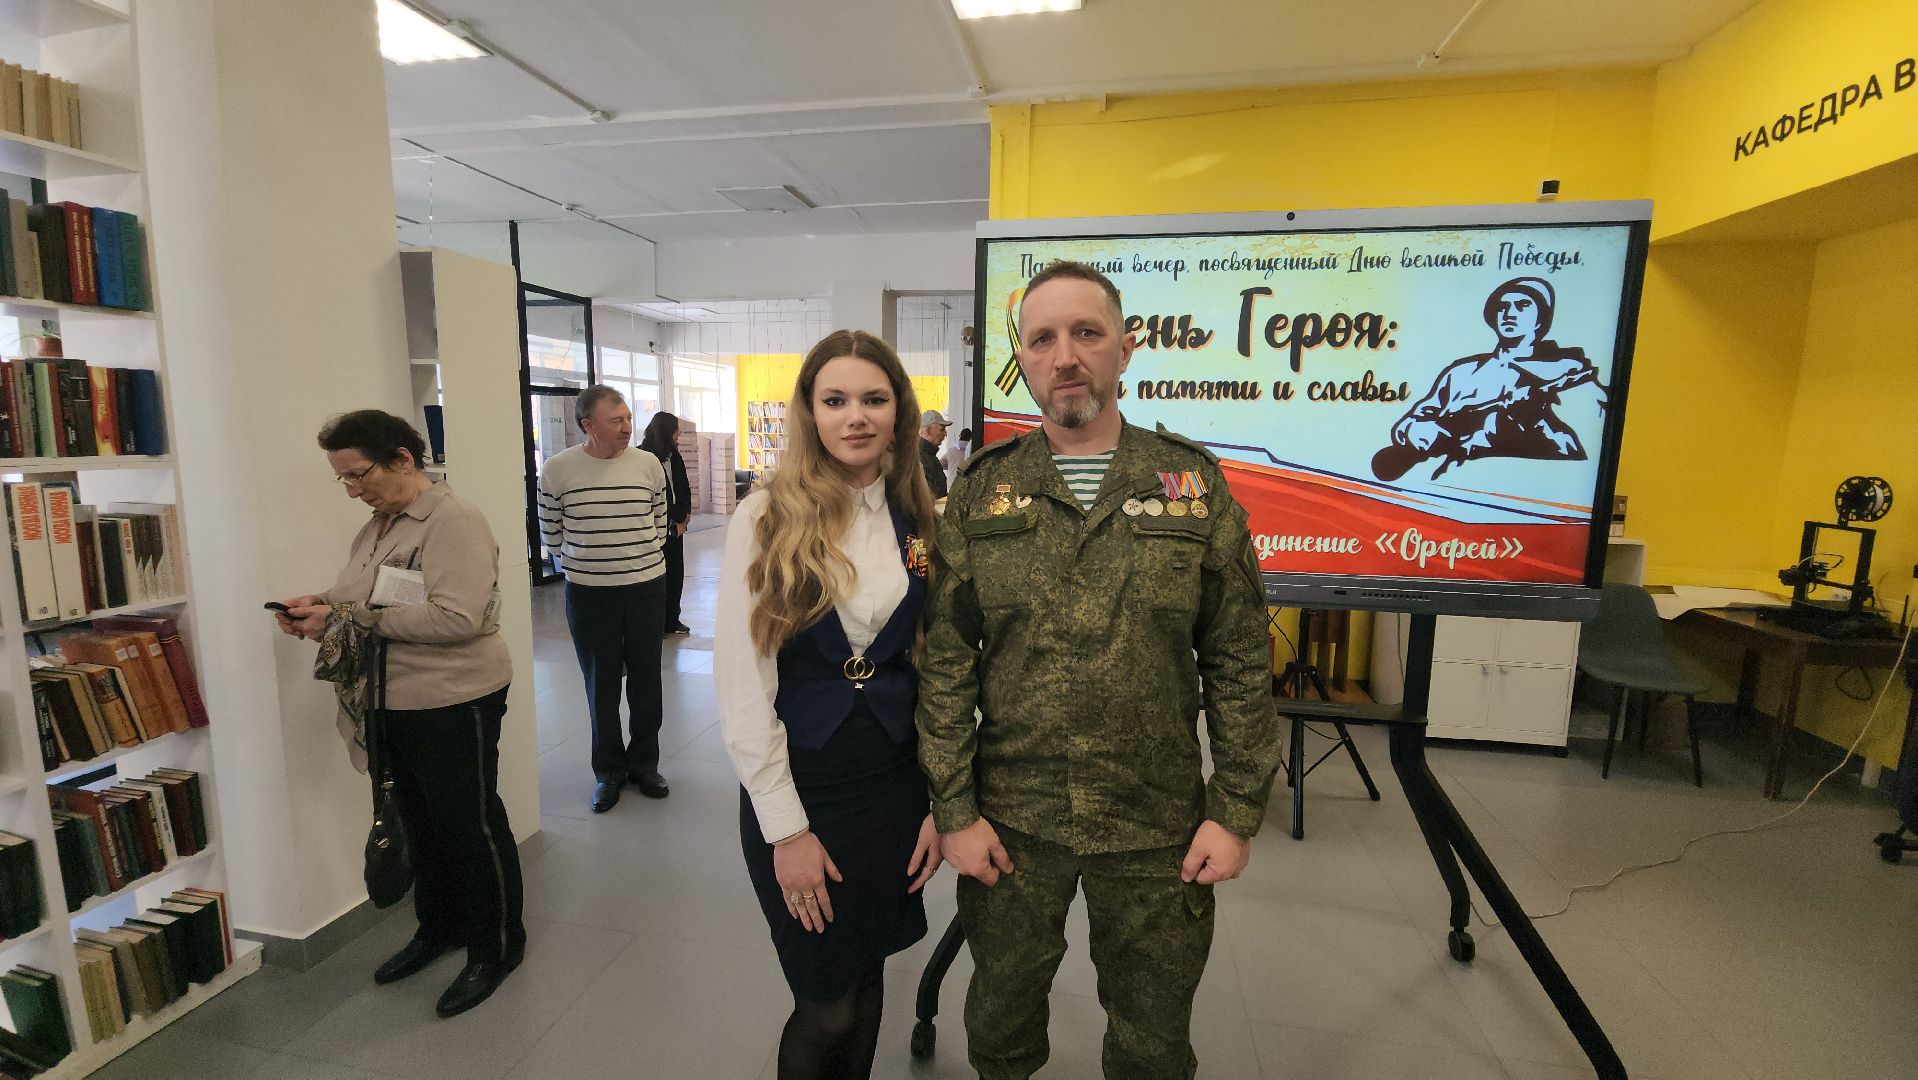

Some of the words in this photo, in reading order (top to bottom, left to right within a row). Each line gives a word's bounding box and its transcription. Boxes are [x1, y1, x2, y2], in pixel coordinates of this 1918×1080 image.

[1733, 74, 1883, 162] КАФЕДРА
[1132, 253, 1190, 282] вечер,
[1198, 250, 1339, 281] посвященный
[1347, 245, 1392, 273] Дню
[1399, 246, 1487, 269] великой
[1124, 314, 1215, 351] ень
[1237, 286, 1399, 374] Героя:
[1137, 379, 1263, 401] памяти
[1272, 380, 1295, 401] и
[1306, 369, 1412, 402] славы
[1251, 533, 1362, 561] динение
[1374, 526, 1524, 570] «Орфей»
